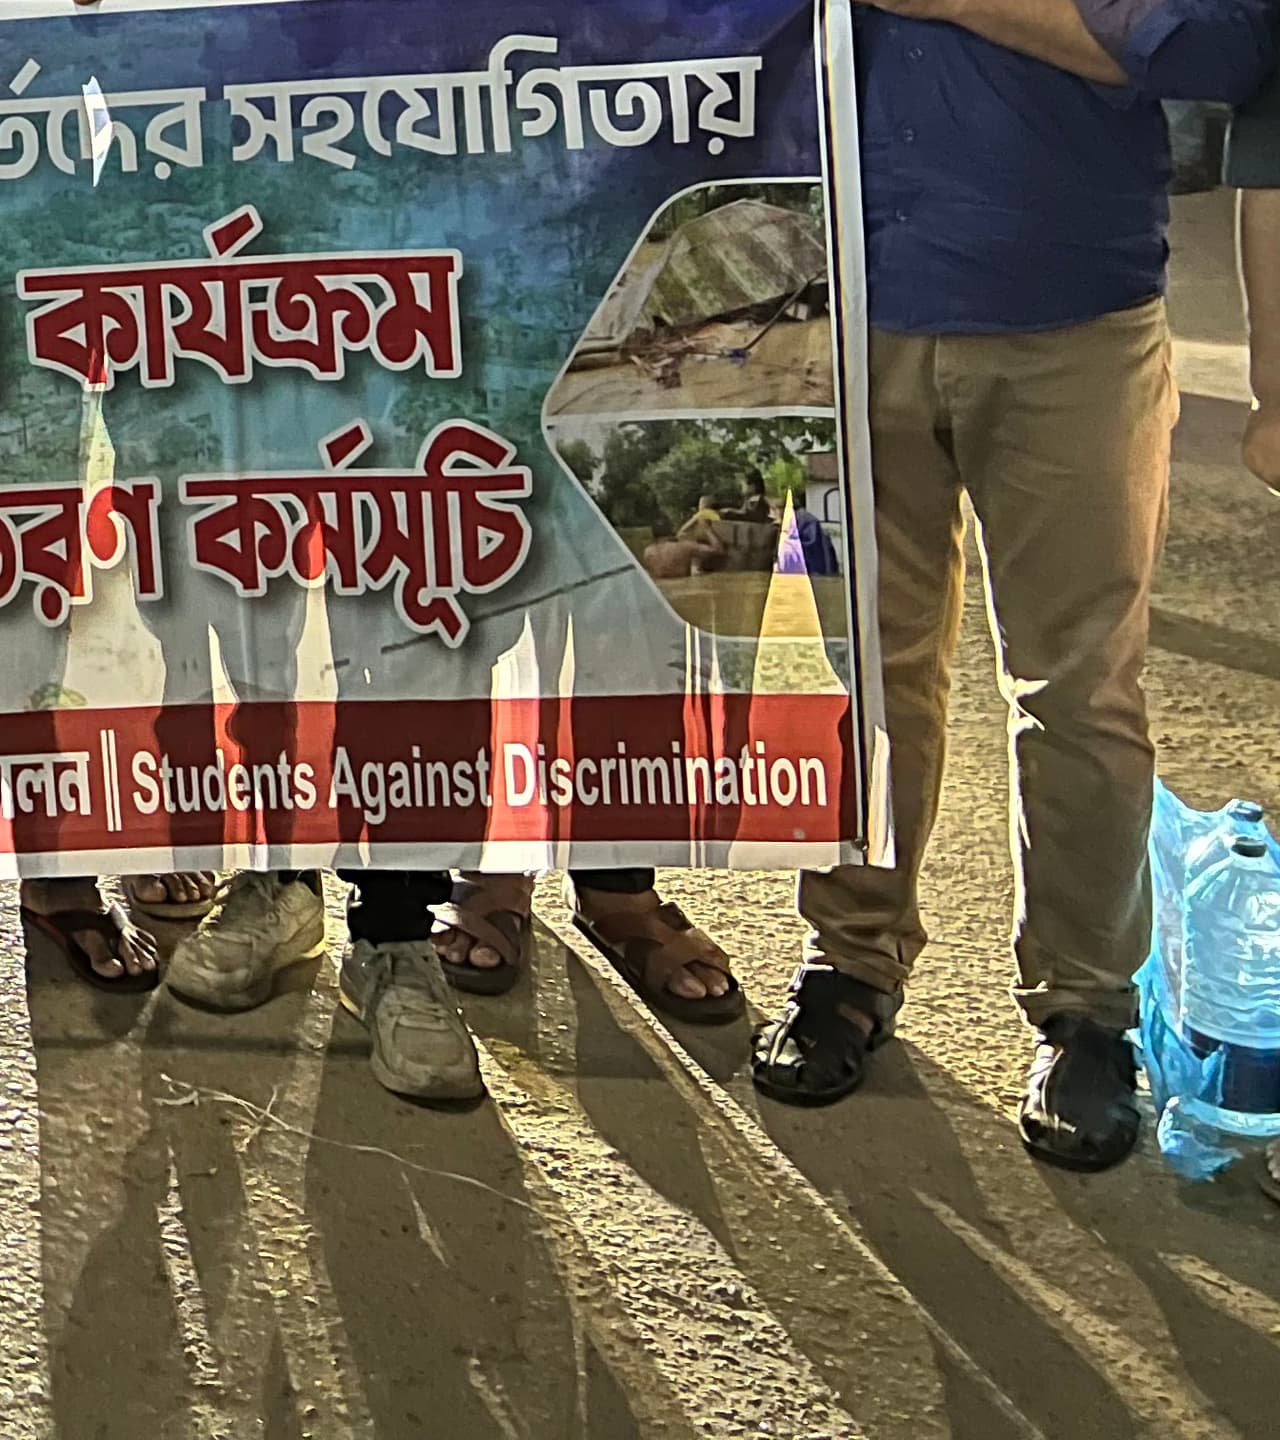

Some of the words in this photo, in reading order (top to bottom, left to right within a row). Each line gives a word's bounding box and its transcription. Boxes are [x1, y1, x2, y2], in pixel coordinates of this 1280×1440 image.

[224, 34, 762, 169] সহযোগিতায়
[15, 204, 463, 384] কার্যক্রম
[179, 418, 533, 648] কর্মসূচি
[131, 750, 314, 814] Students
[328, 746, 492, 825] Against
[503, 740, 827, 809] Discrimination
